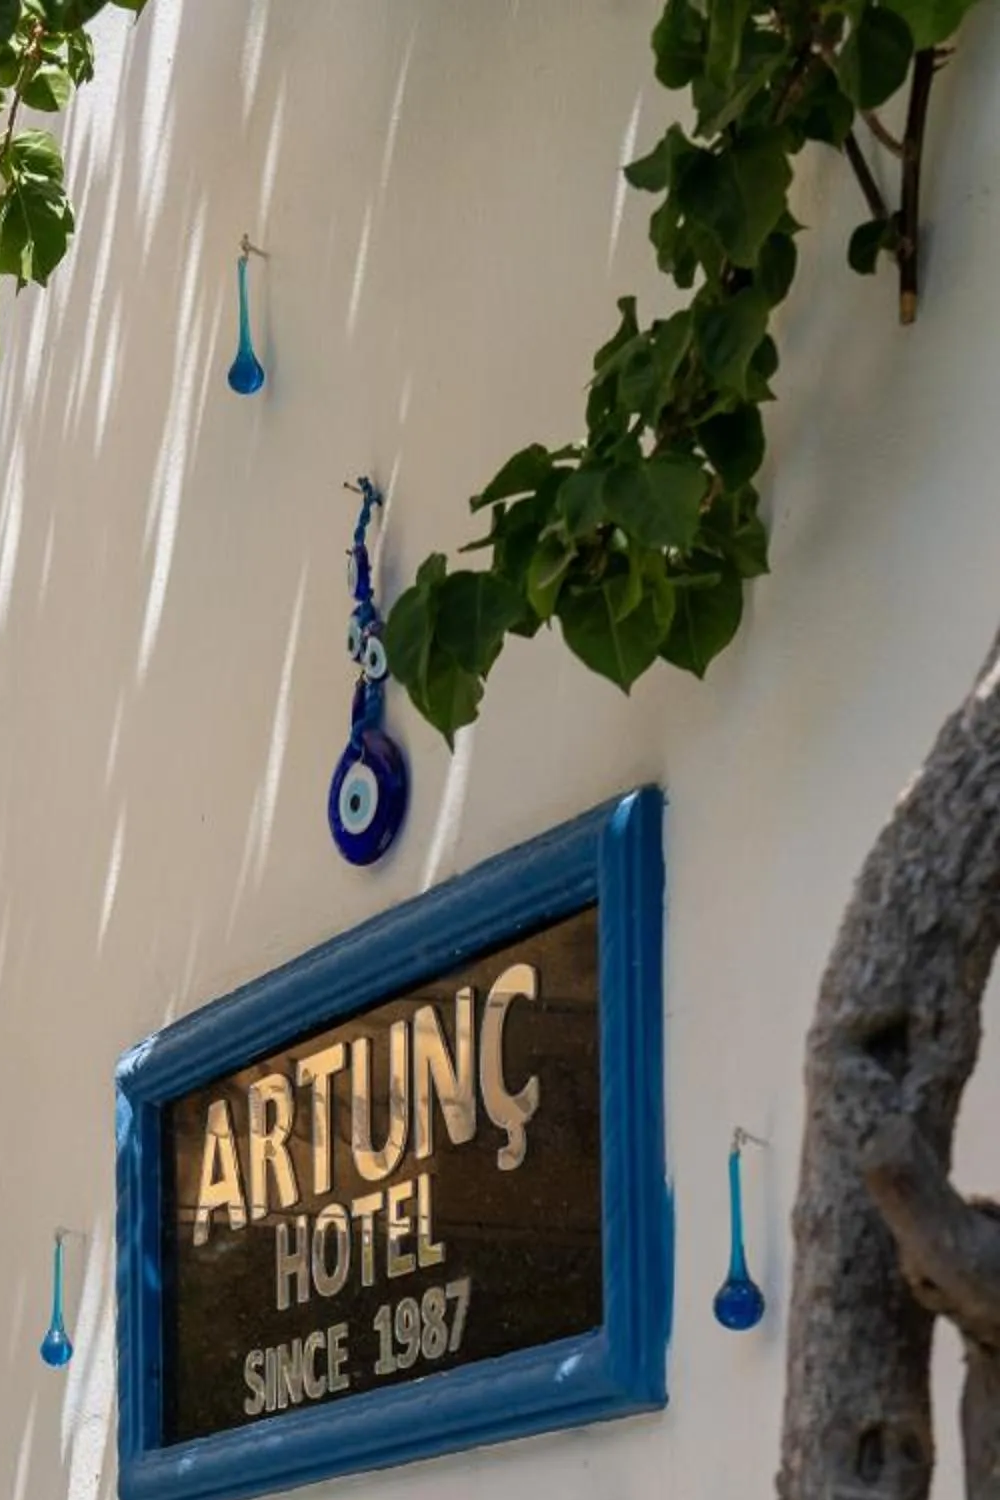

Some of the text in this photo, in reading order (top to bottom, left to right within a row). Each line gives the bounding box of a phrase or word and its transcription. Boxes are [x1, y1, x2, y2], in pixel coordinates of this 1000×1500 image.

[193, 963, 540, 1246] ARTUNÇ
[275, 1173, 446, 1310] HOTEL
[243, 1277, 472, 1416] SINCE 1987
